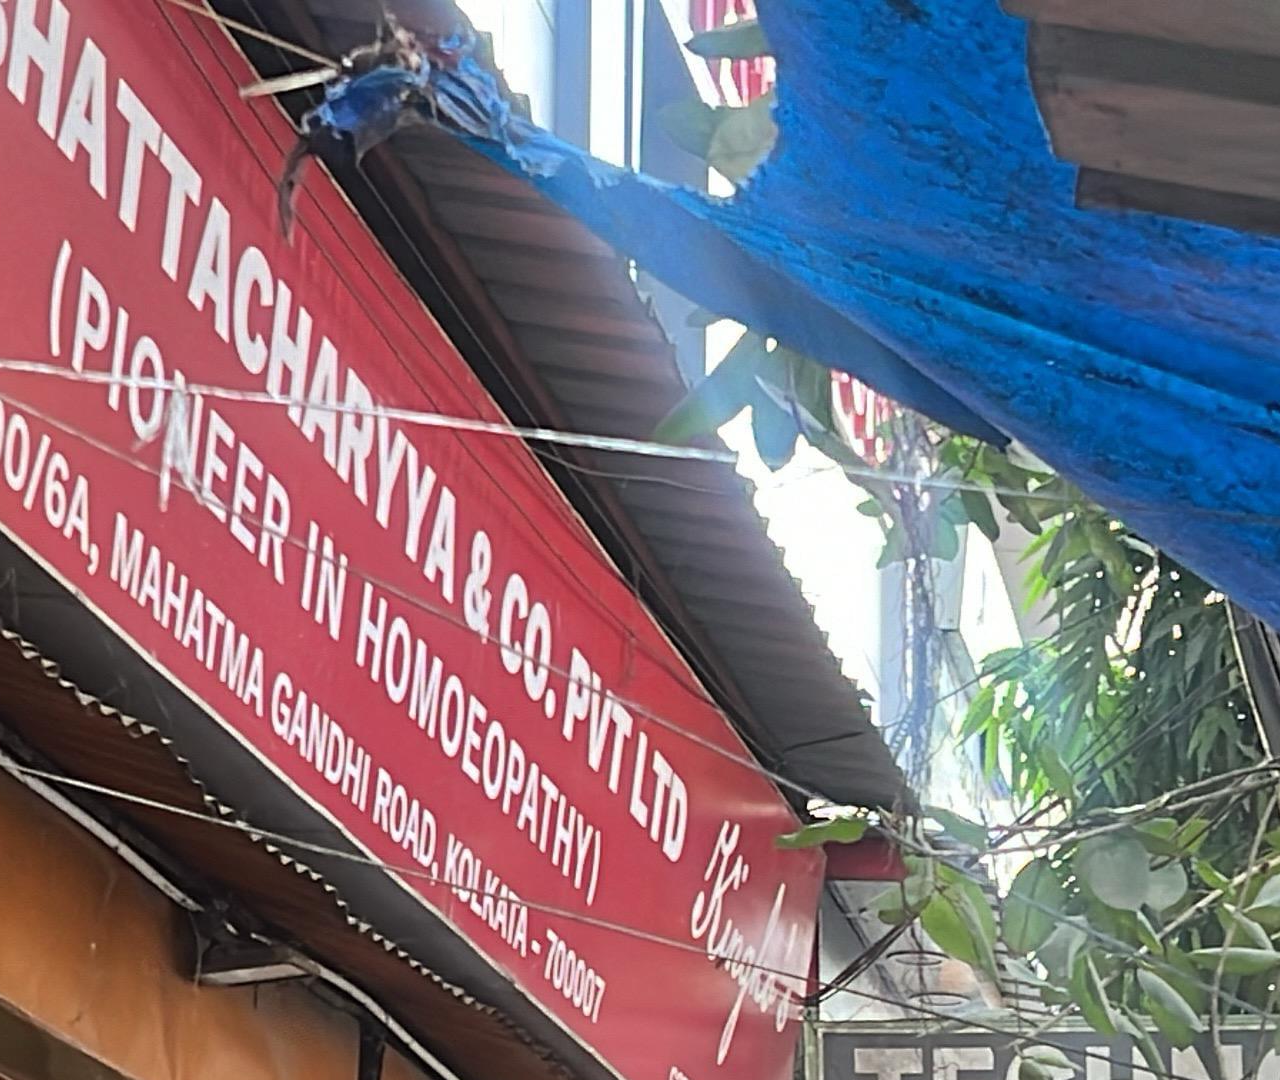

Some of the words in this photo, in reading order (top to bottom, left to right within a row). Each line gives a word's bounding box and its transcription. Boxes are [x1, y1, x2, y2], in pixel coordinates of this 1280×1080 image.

[50, 240, 290, 584] (PIONEER
[301, 522, 347, 641] IN
[356, 581, 603, 905] HOMOEOPATHY)
[110, 512, 264, 717] MAHATMA
[271, 675, 372, 805] GANDHI
[372, 763, 440, 887] ROAD,
[443, 831, 529, 959] KOLKATA
[544, 928, 607, 1024] 700007
[464, 531, 493, 644] &
[562, 649, 634, 793] PVT
[629, 715, 688, 863] LTD
